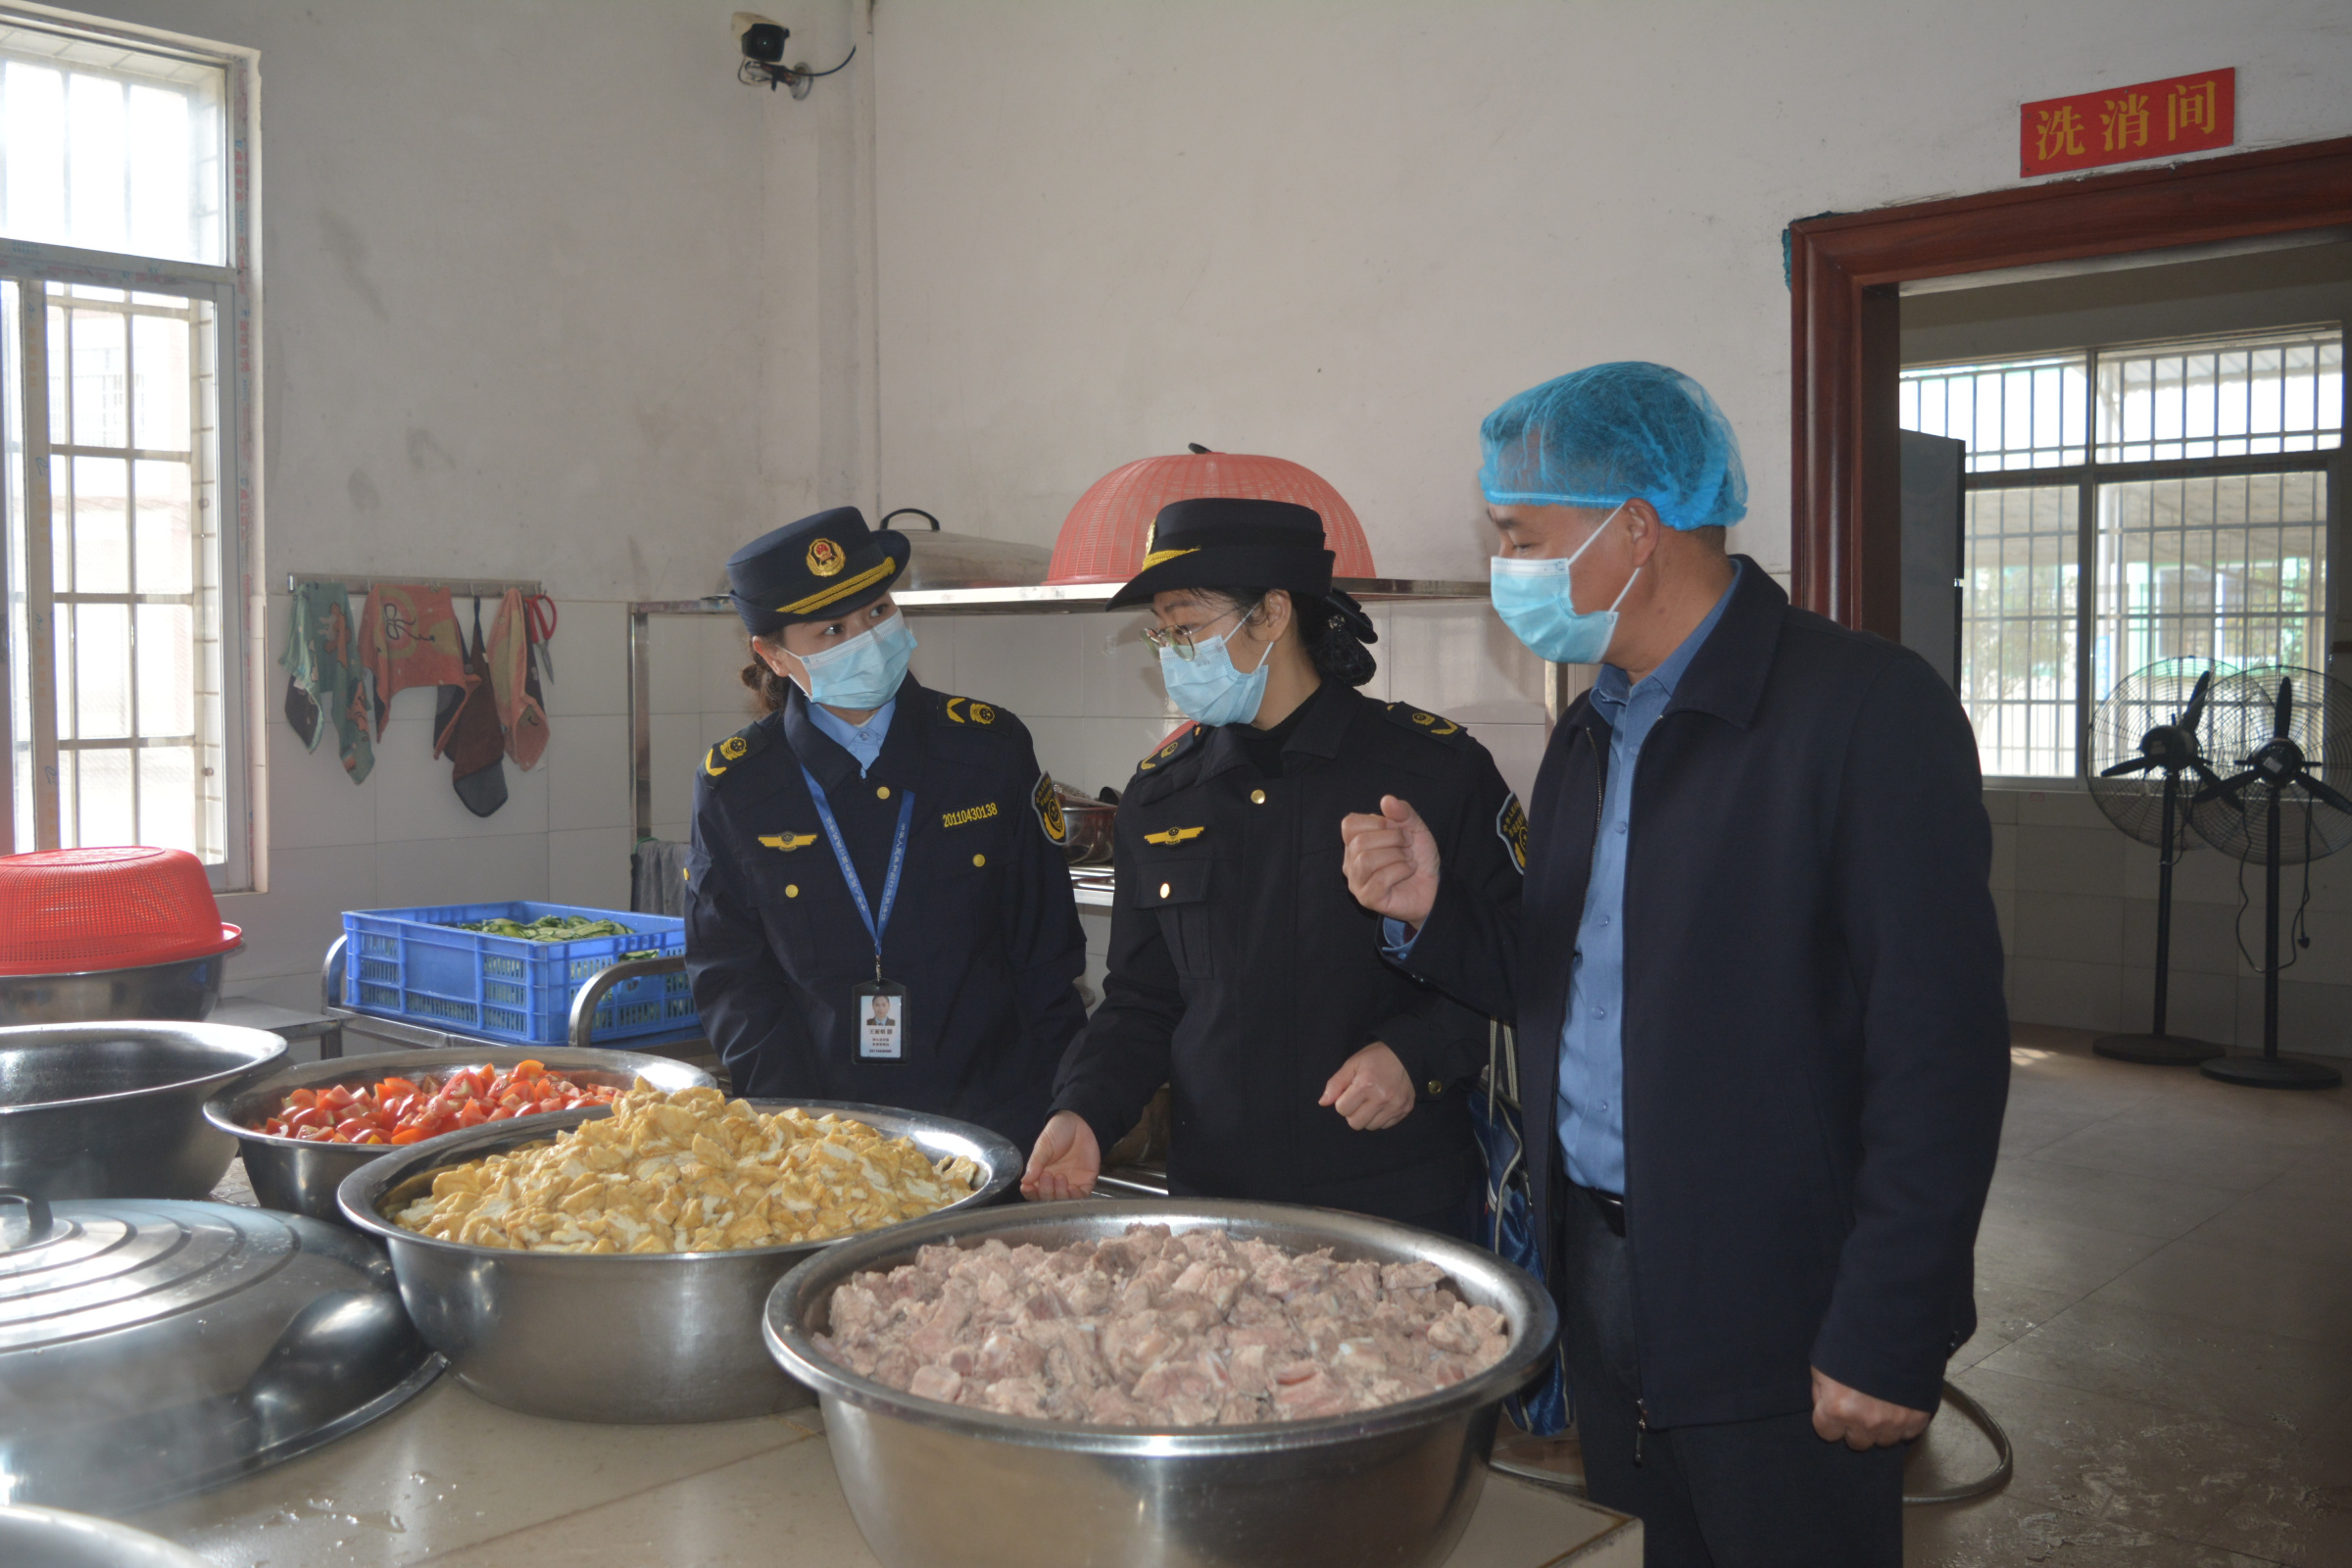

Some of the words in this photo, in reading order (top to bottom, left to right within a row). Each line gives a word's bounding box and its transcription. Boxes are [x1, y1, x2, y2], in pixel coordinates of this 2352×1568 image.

[2035, 80, 2216, 161] 洗消间
[942, 802, 998, 828] 20110430138
